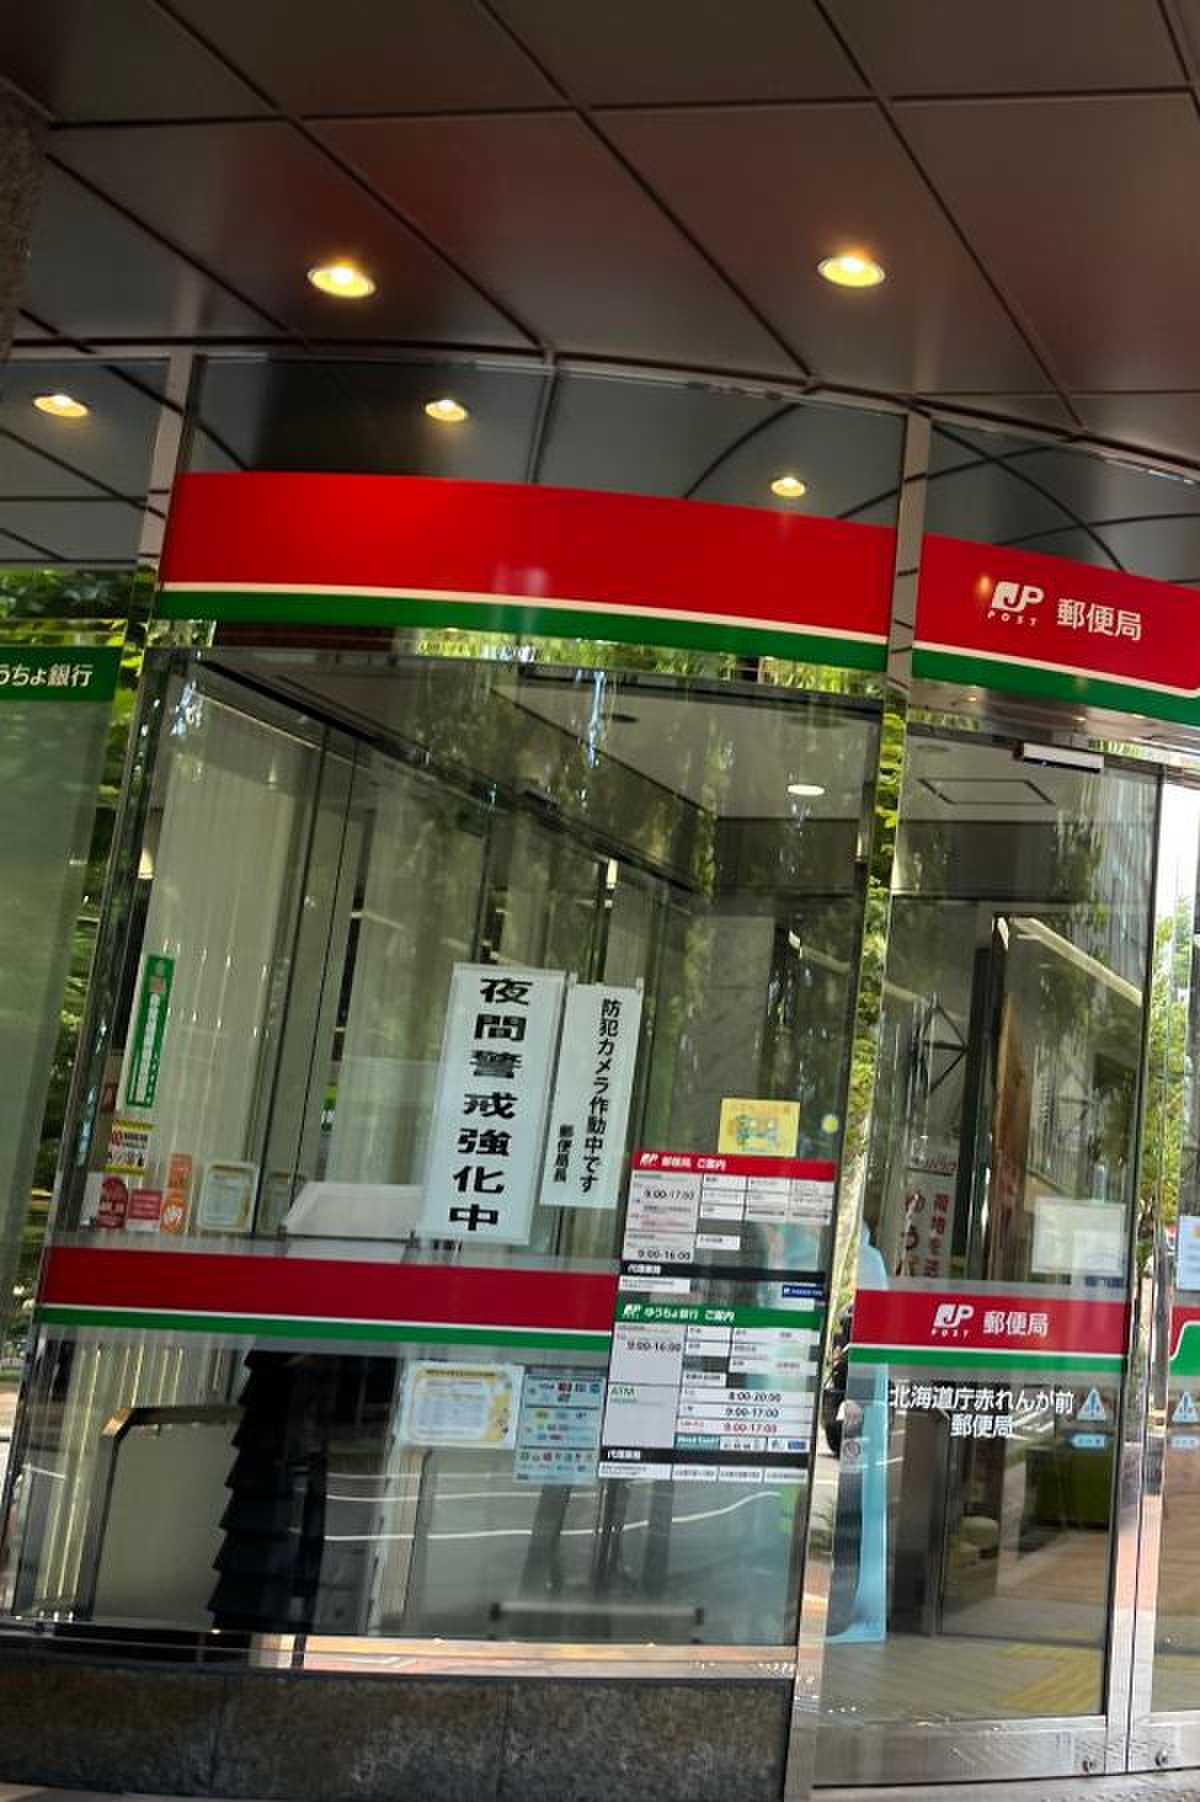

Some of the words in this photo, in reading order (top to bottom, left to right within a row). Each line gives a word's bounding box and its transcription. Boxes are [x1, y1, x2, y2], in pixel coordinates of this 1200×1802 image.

[987, 611, 1041, 627] POST
[1056, 598, 1142, 641] 郵便局
[449, 977, 534, 1231] 夜間警戒強化中
[579, 998, 623, 1193] 防犯カメラ作動中です
[983, 1311, 1048, 1337] 郵便局
[889, 1385, 1074, 1415] 北海道庁赤れんが前
[951, 1414, 1014, 1438] 郵便局
